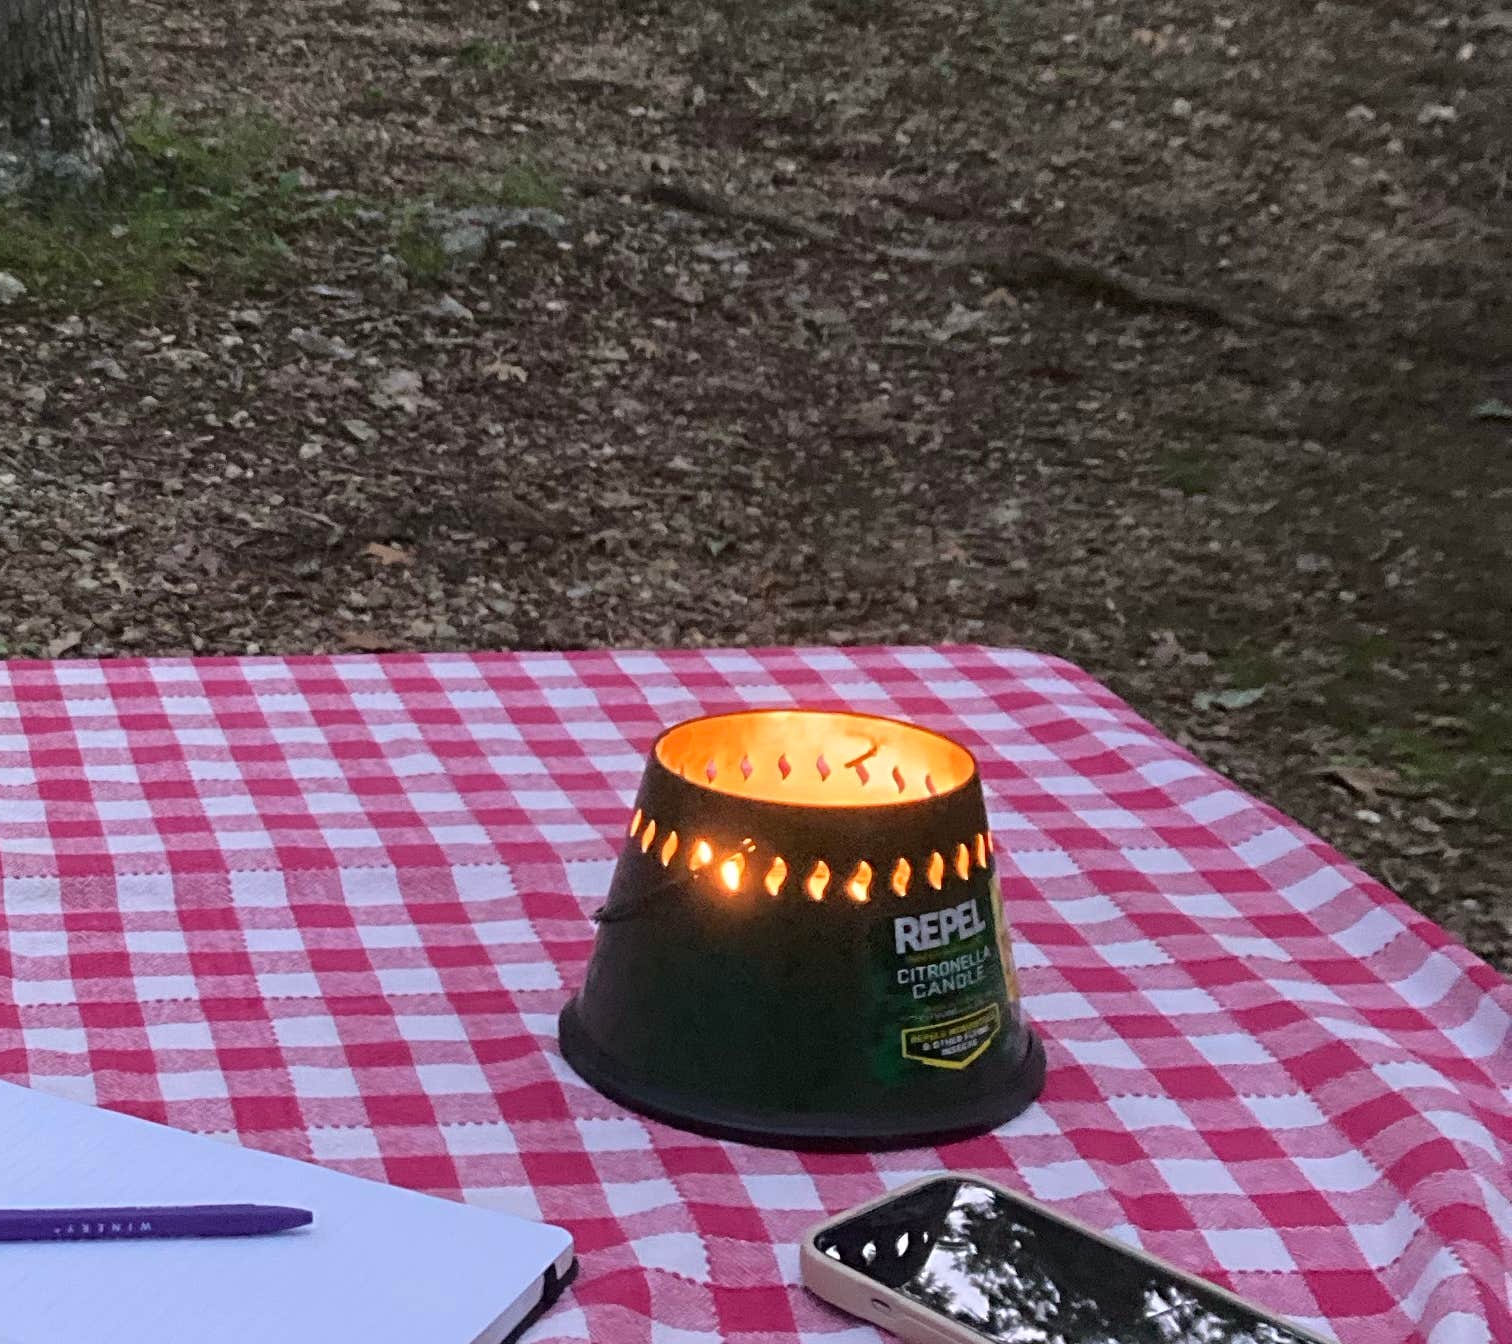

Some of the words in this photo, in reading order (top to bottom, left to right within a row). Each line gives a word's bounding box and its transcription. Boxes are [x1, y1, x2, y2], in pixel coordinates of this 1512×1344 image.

[894, 898, 987, 955] REPEL
[897, 944, 992, 985] CITRONELLA
[911, 965, 986, 1000] CANDLE
